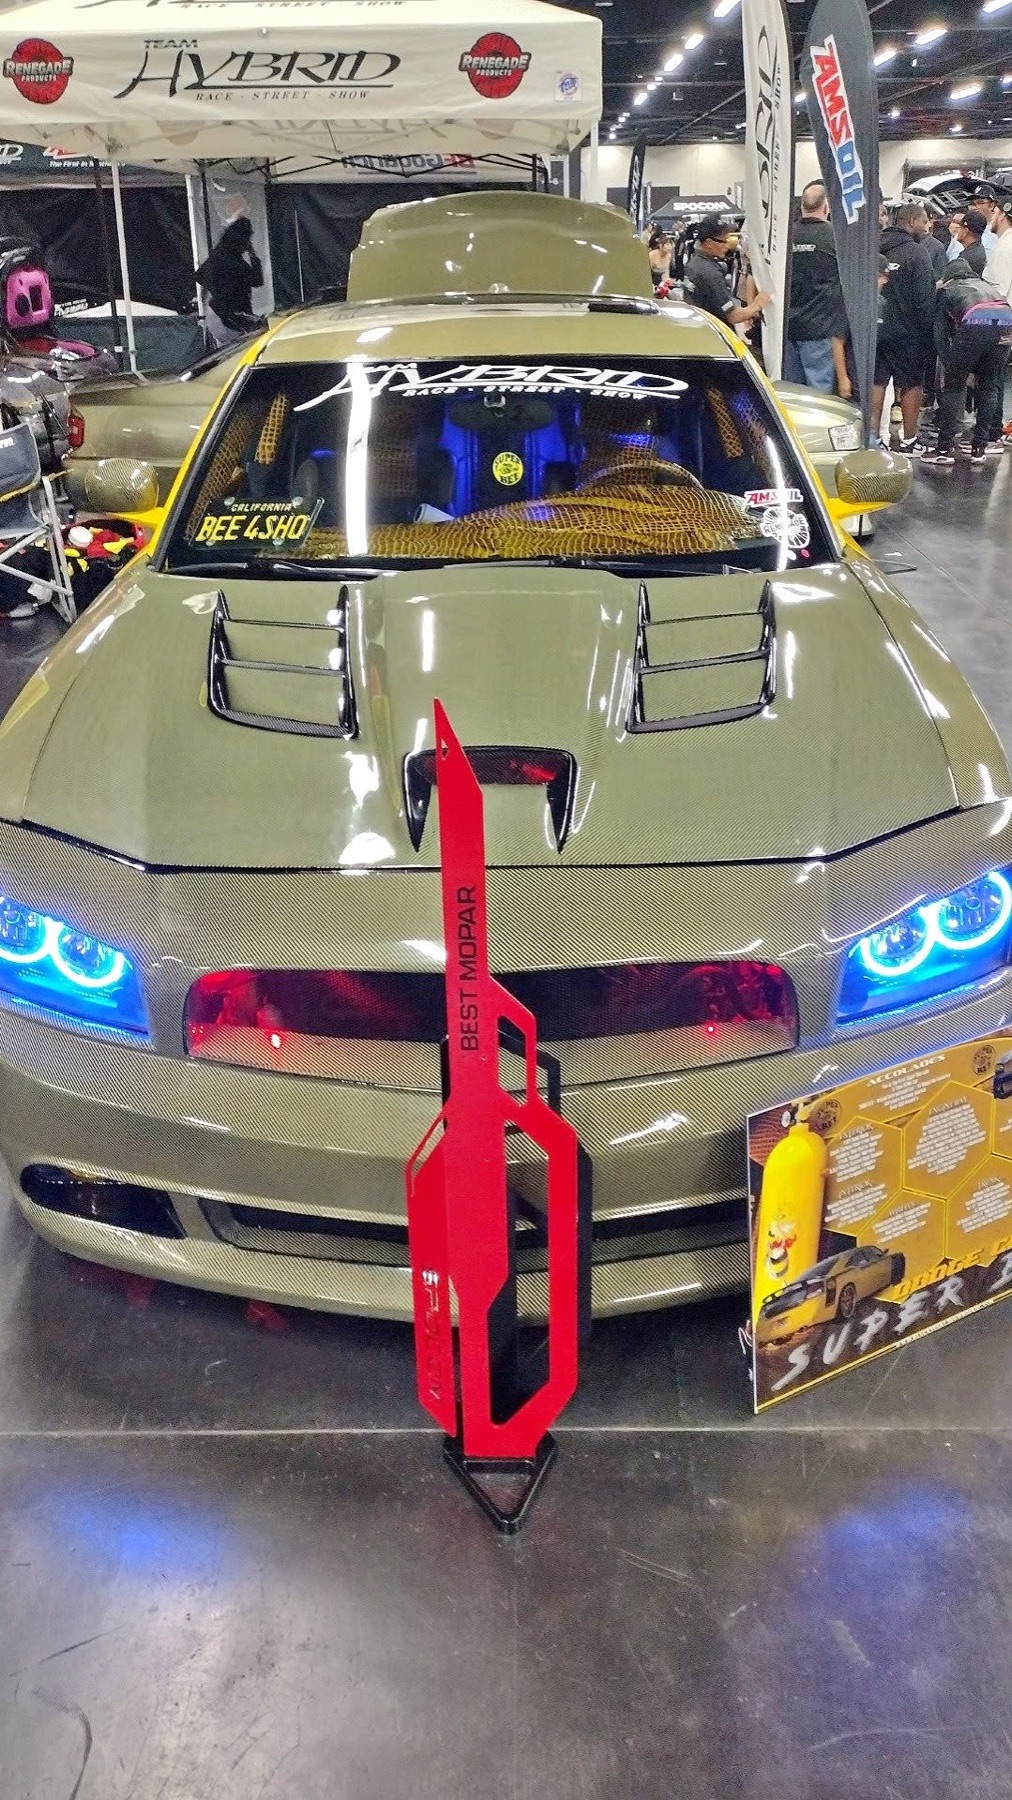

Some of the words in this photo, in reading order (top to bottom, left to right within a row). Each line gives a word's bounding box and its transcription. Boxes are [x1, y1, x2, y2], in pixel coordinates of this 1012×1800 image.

[144, 39, 199, 49] TEAM
[6, 60, 72, 75] RENEGADE
[461, 54, 529, 69] RENEGADE
[113, 49, 402, 98] HYBRID
[196, 91, 233, 101] RACE
[252, 91, 311, 100] STREET
[328, 90, 370, 99] SHOW
[813, 41, 864, 218] AMSOIL
[673, 201, 732, 211] SPOCOM
[293, 363, 690, 411] HYBRID
[402, 386, 458, 397] RACE
[483, 384, 566, 394] STREET
[590, 388, 648, 400] SHOW
[231, 502, 293, 512] CALIFORNIA
[195, 515, 247, 541] BEE
[456, 886, 477, 981] MOPAR
[460, 987, 478, 1051] BEST
[770, 1275, 965, 1392] SUPER
